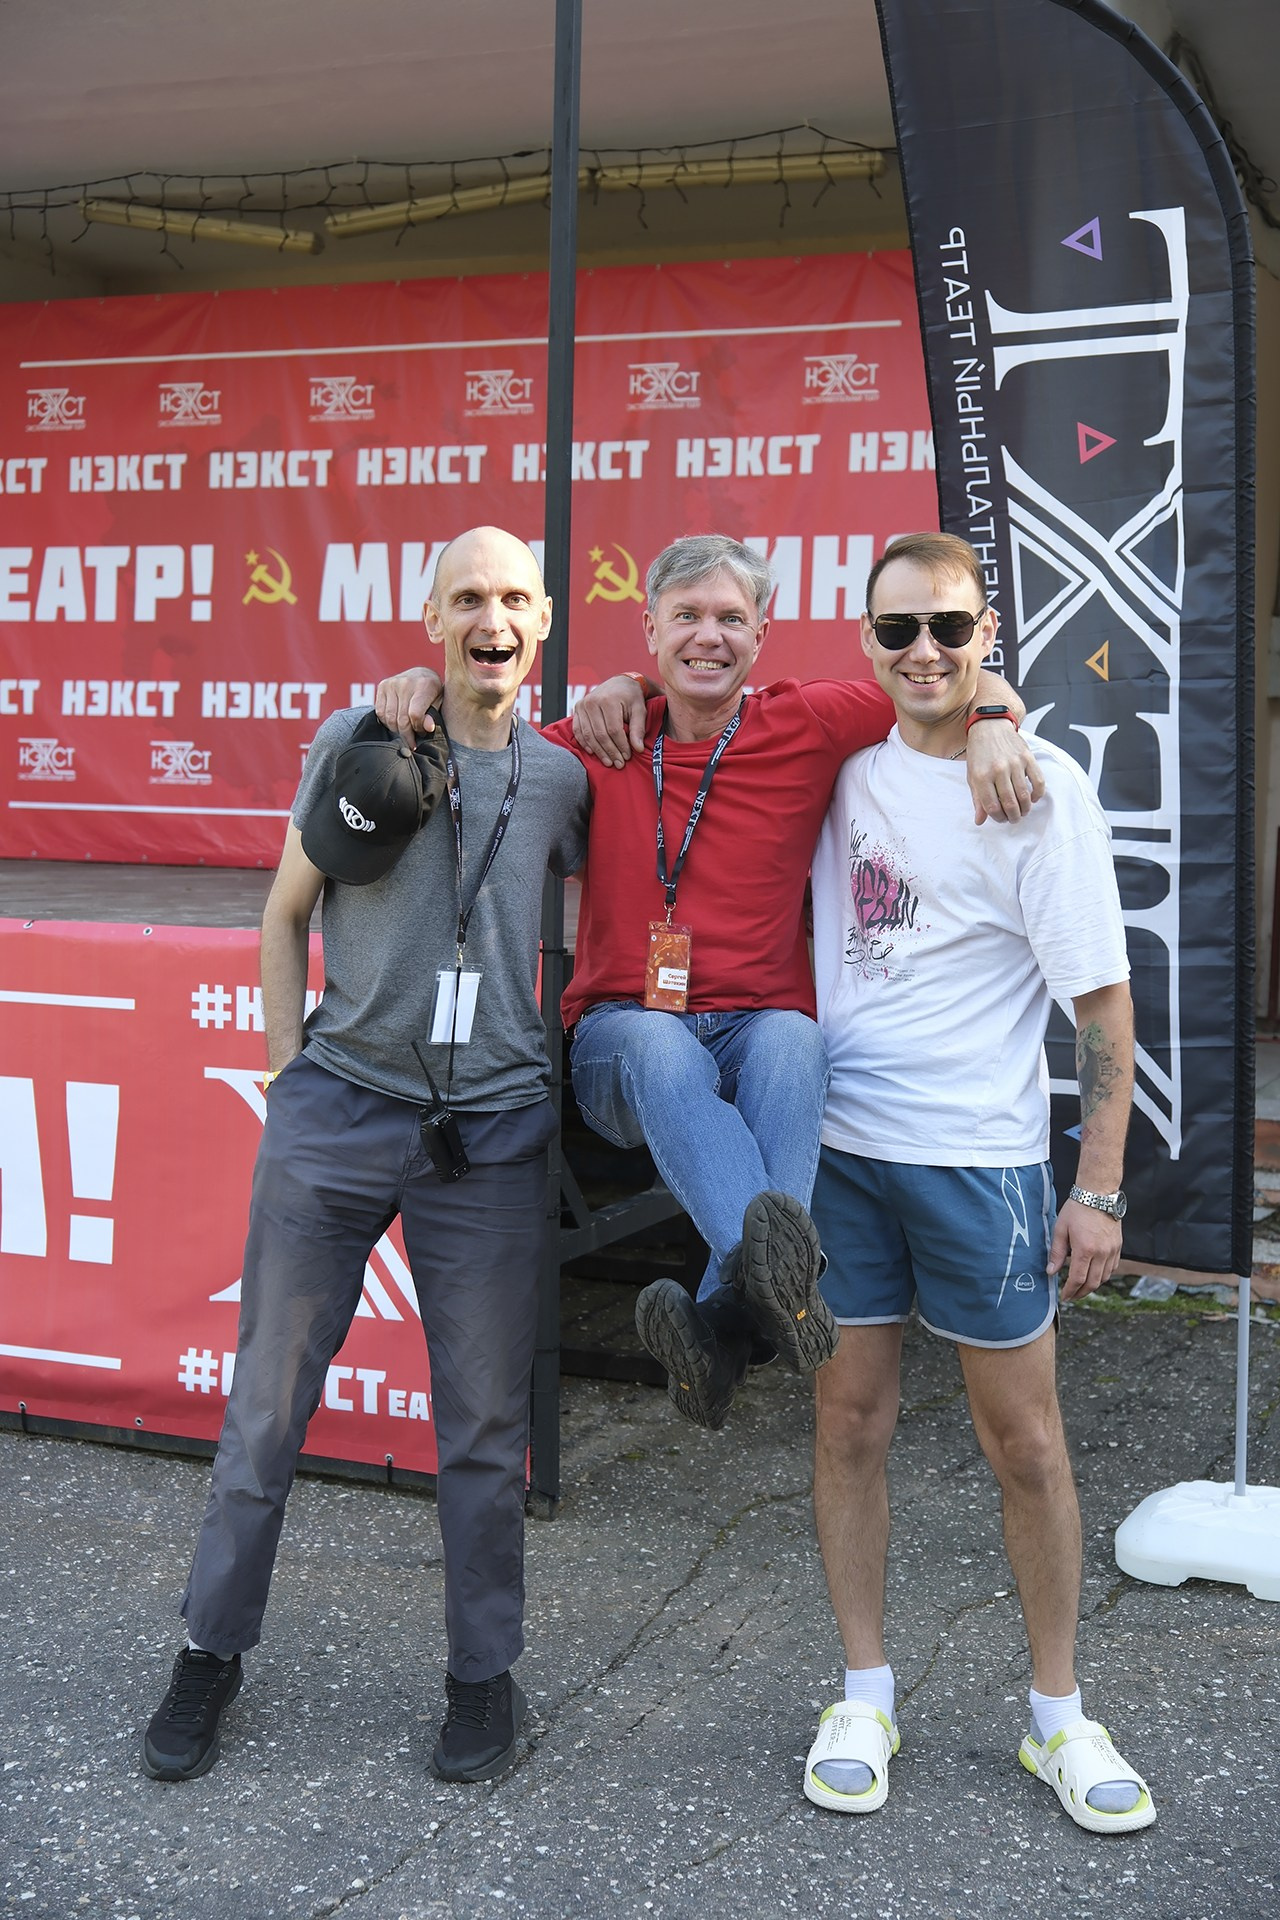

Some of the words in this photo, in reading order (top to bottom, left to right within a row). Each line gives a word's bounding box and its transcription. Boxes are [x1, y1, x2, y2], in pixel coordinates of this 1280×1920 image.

[69, 453, 188, 493] НЭКСТ
[209, 450, 333, 489] НЭКСТ
[356, 445, 487, 486] НЭКСТ
[512, 440, 650, 483] НКСТ
[676, 434, 821, 478] НЭКСТ
[0, 544, 214, 622] ЕАТР!
[61, 680, 181, 717] НЭКСТ
[201, 682, 327, 719] НЭКСТ
[652, 734, 664, 765] NEXT
[689, 790, 707, 827] NEXT
[657, 818, 665, 850] NEX
